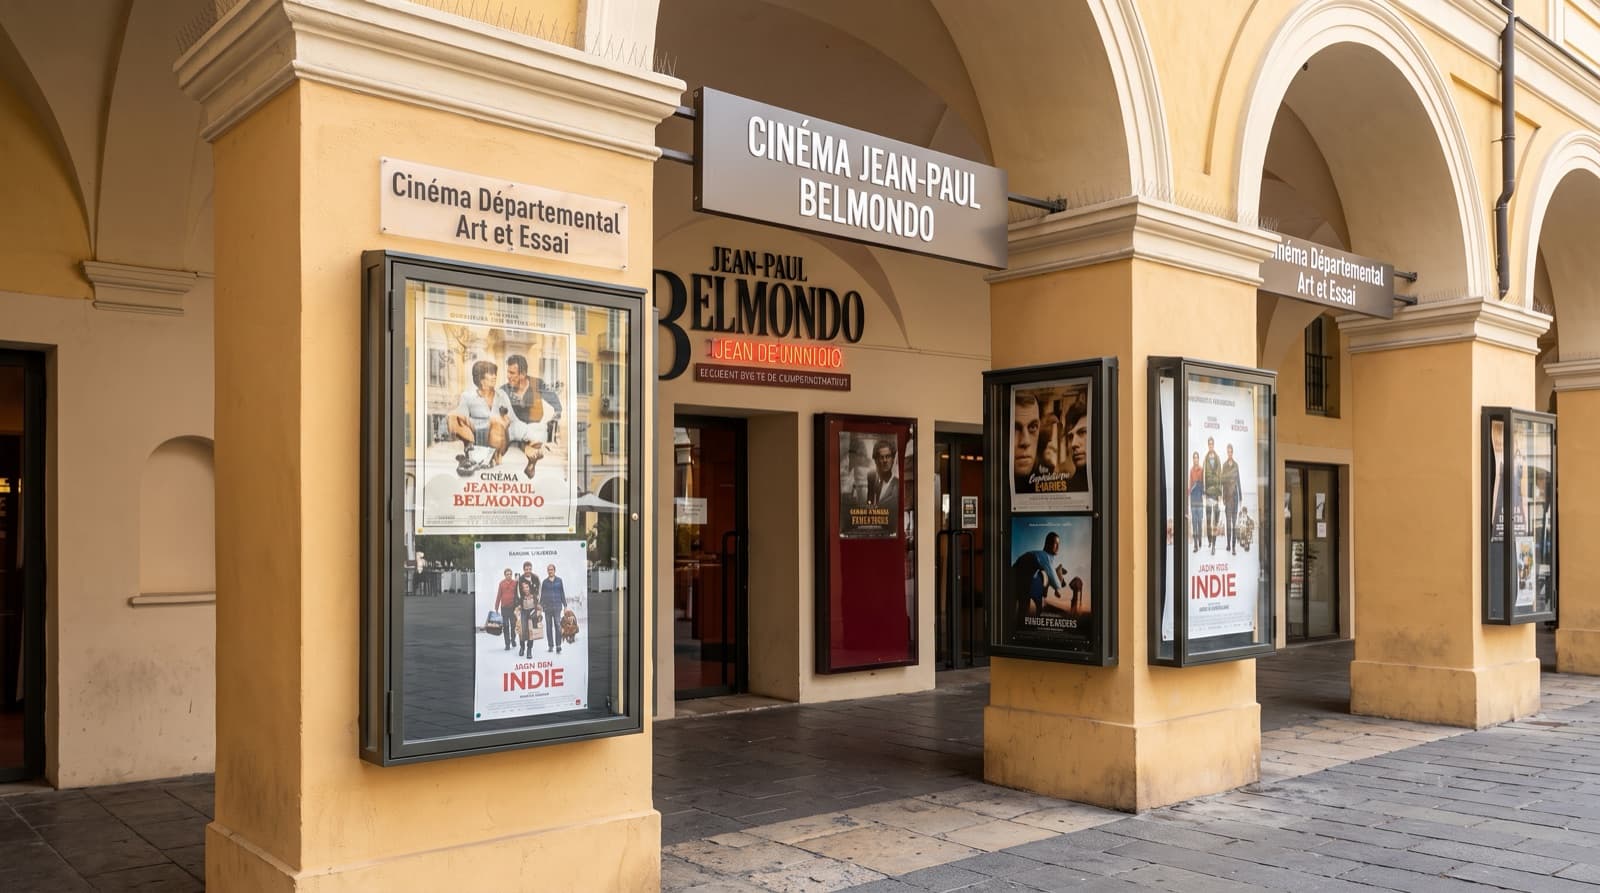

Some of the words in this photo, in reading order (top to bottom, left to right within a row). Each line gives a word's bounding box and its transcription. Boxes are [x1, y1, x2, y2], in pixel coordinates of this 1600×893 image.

[748, 115, 852, 178] CINÉMA
[858, 144, 982, 210] JEAN-PAUL
[392, 171, 472, 209] Cinéma
[478, 187, 621, 235] Départemental
[799, 177, 935, 243] BELMONDO
[455, 214, 488, 242] Art
[493, 226, 513, 247] et
[519, 224, 569, 255] Essai
[710, 246, 809, 282] JEAN-PAUL
[1310, 247, 1385, 287] Départemental
[1297, 271, 1315, 296] Art
[1316, 279, 1328, 299] et
[1329, 279, 1356, 306] Essai
[463, 482, 536, 495] JEAN-PAUL
[480, 470, 519, 482] CINÉMA
[453, 493, 545, 508] BELMONDO
[1191, 573, 1237, 600] INDIE
[503, 668, 565, 692] INDIE
